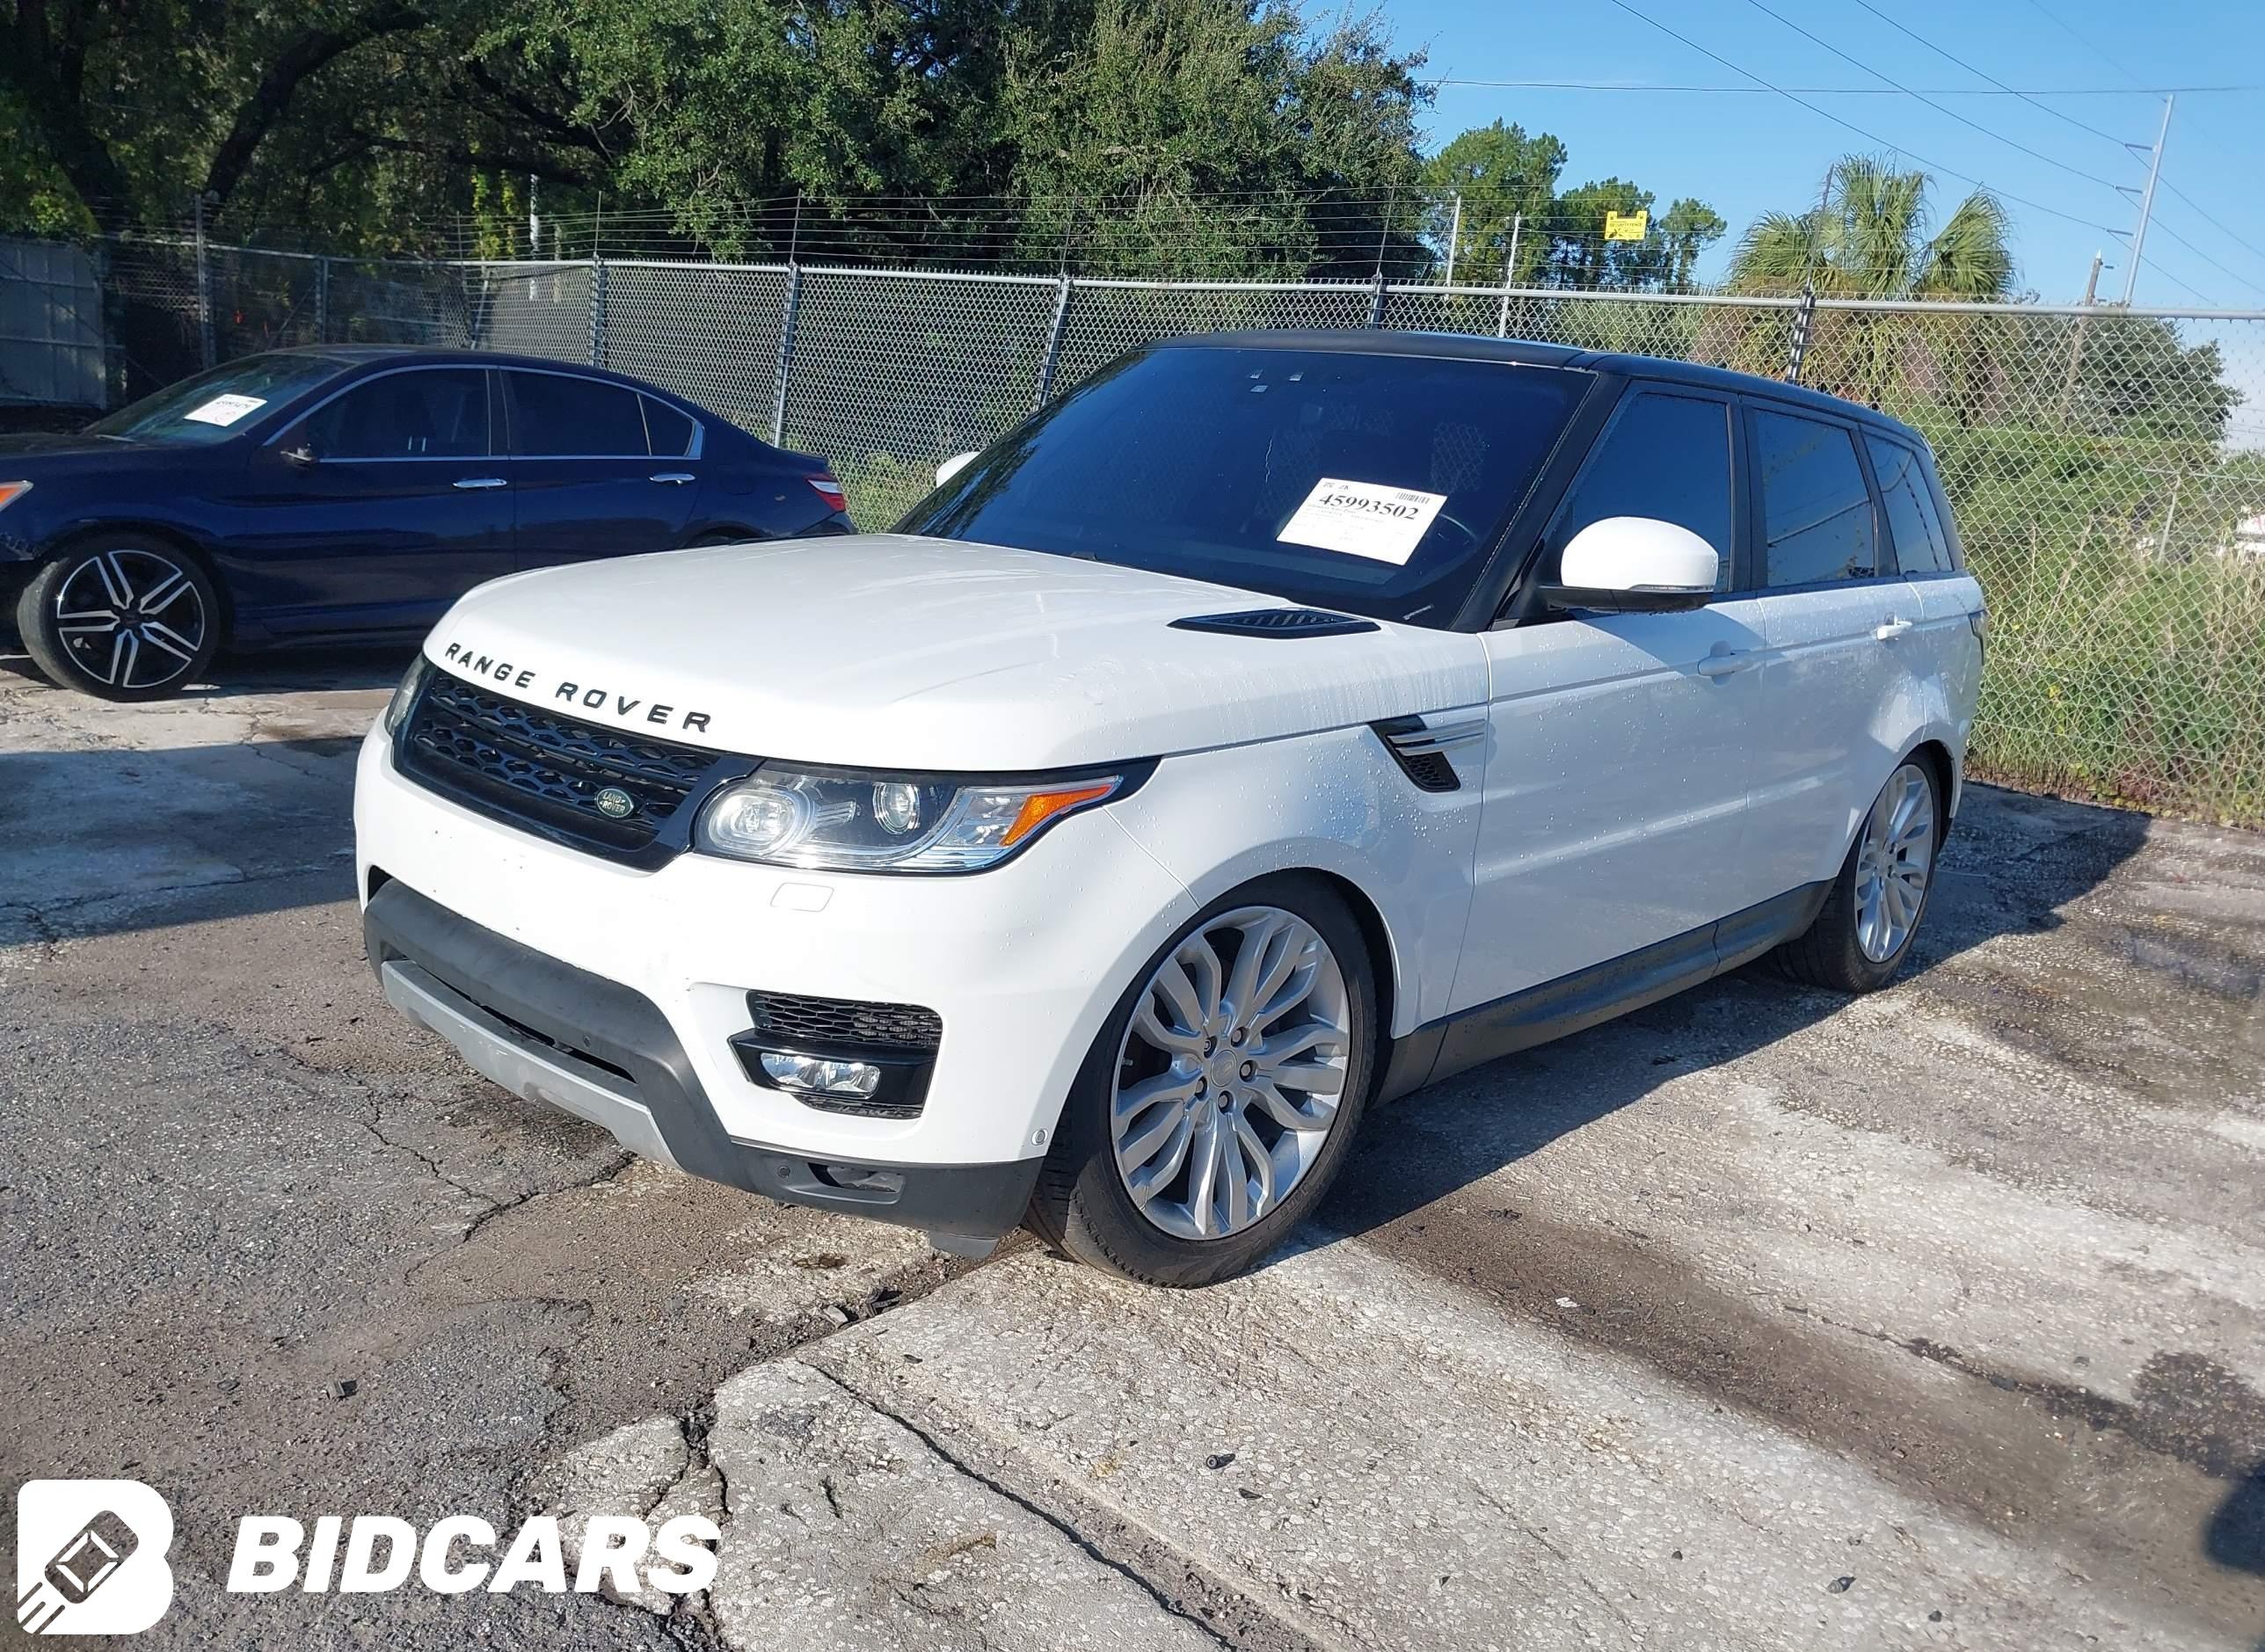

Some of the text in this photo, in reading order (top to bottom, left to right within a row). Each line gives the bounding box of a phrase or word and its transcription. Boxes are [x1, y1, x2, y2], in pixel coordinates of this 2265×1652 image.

[1319, 493, 1418, 520] 45993502
[445, 643, 711, 732] RANGE ROVER
[601, 800, 626, 814] ROVER
